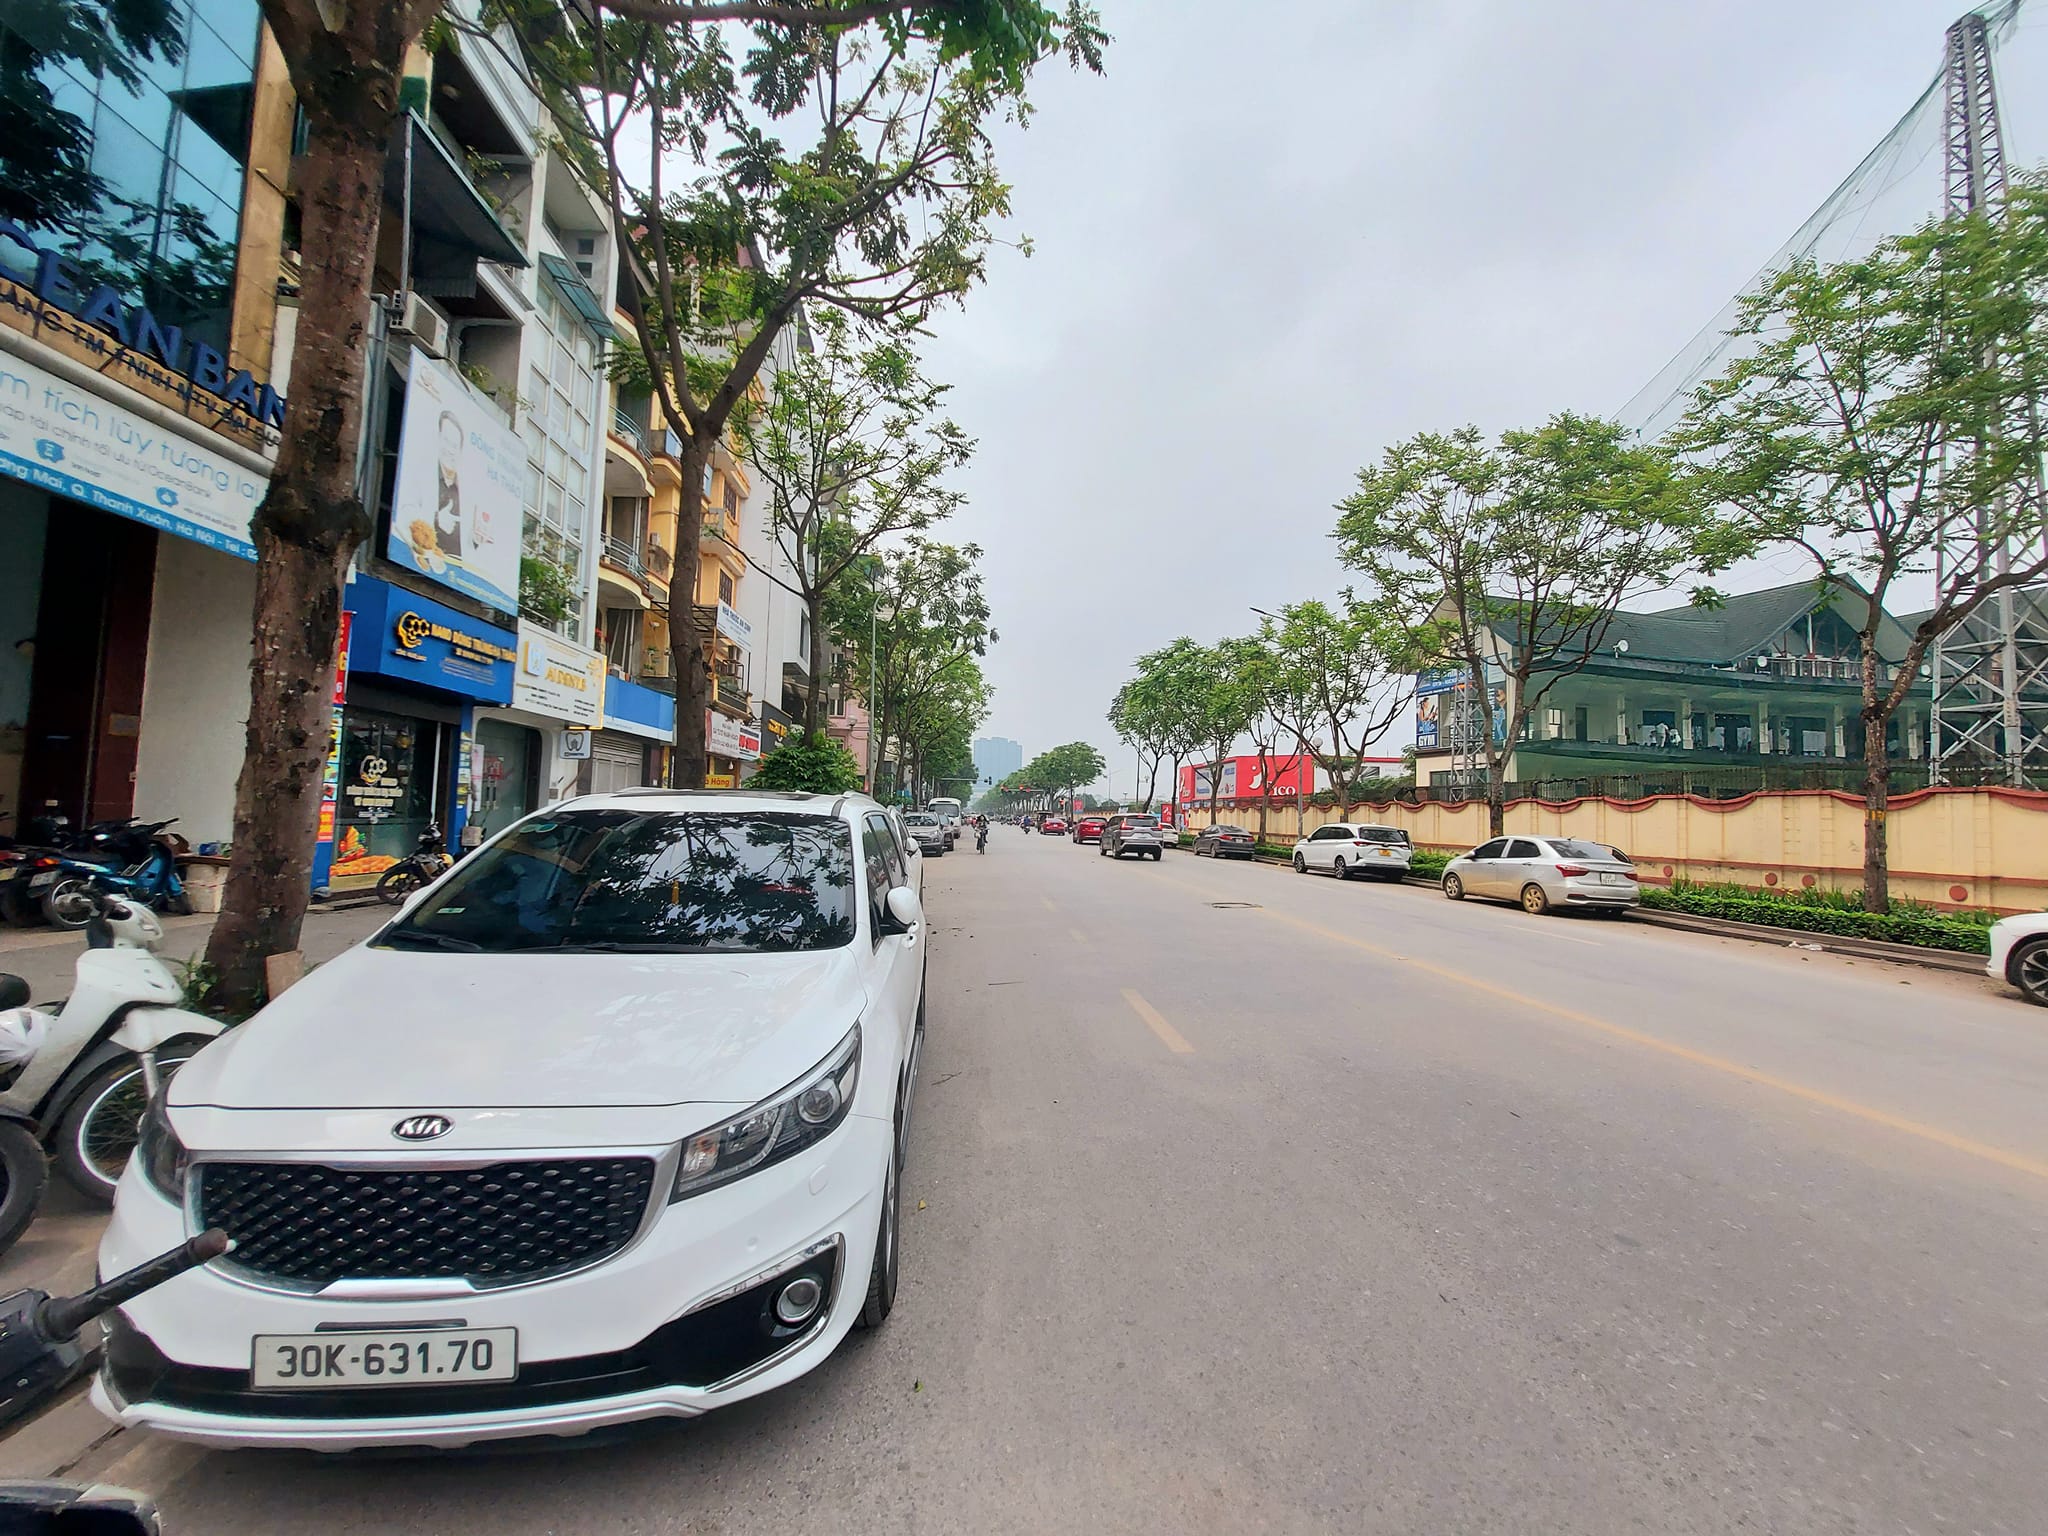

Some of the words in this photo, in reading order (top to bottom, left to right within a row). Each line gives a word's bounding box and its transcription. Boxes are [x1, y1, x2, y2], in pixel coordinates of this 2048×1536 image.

[190, 339, 288, 428] BAN
[43, 386, 100, 431] tích
[110, 416, 153, 455] lũy
[161, 441, 231, 492] tương
[92, 490, 135, 516] Thanh
[1418, 734, 1436, 747] GYM
[399, 1117, 443, 1135] KIA
[276, 1338, 494, 1379] 30K-631.70
